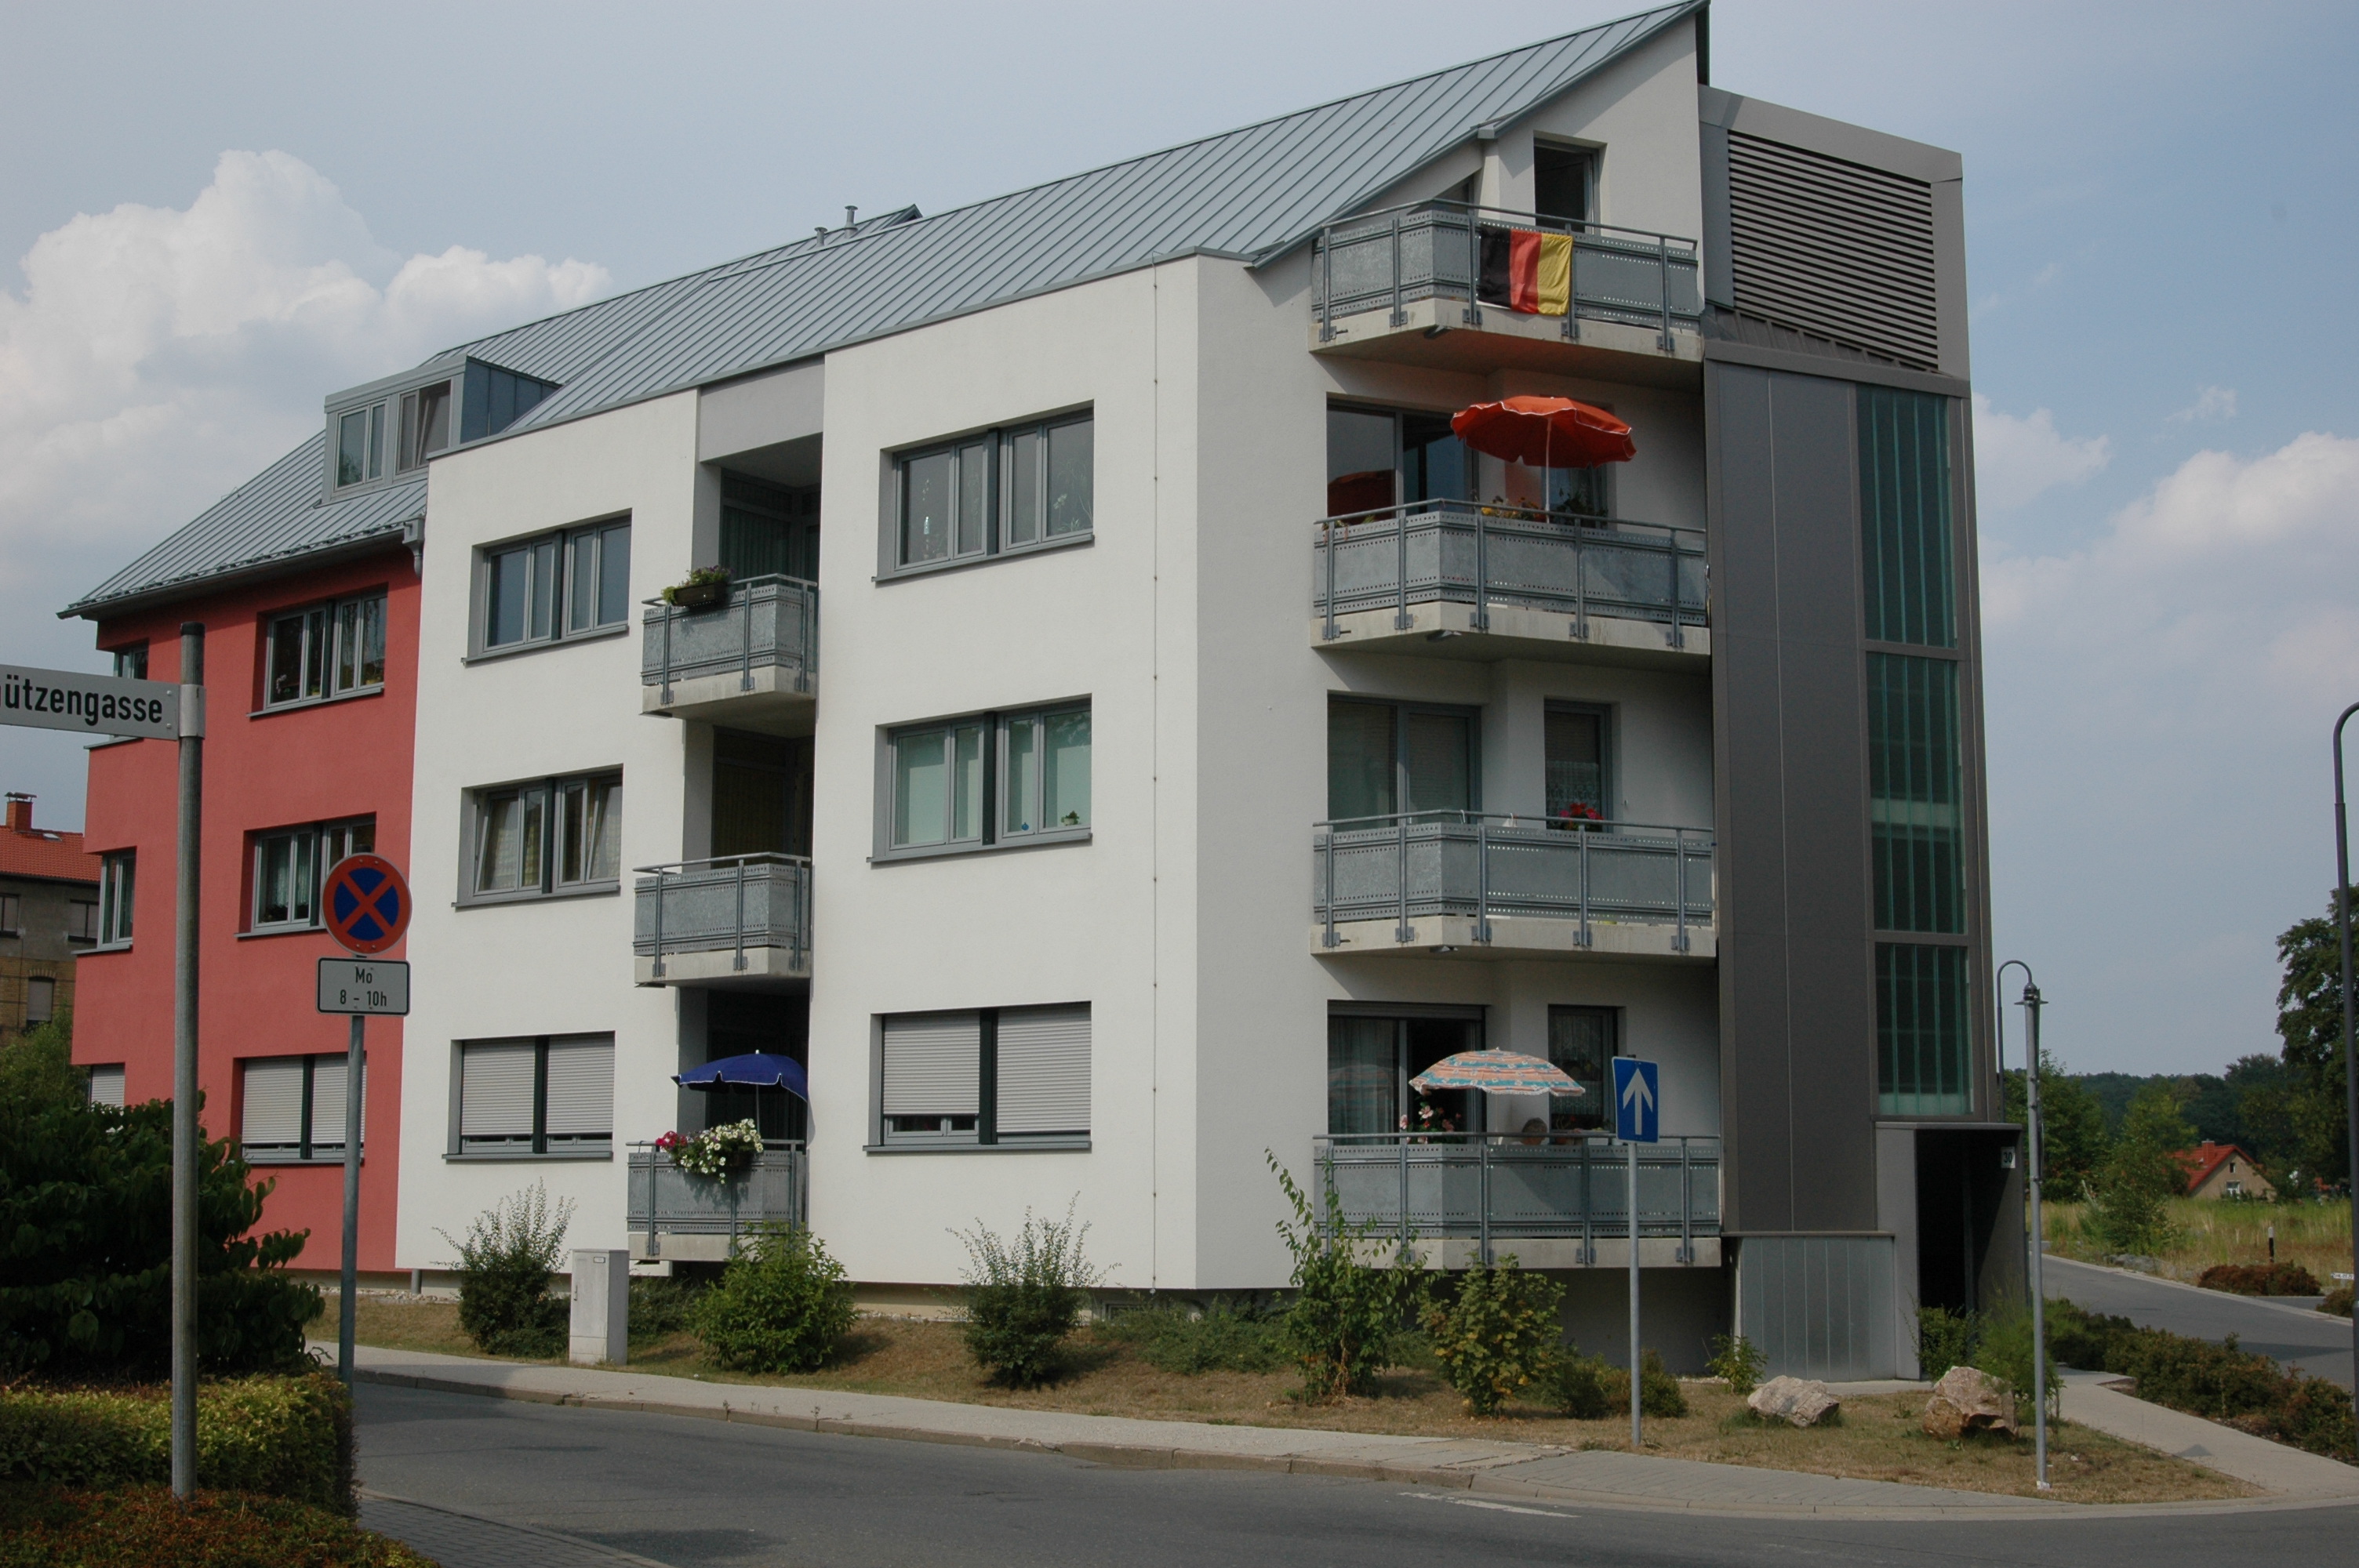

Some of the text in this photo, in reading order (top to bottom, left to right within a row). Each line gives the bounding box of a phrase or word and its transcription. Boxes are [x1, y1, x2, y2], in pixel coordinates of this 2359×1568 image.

[0, 673, 163, 726] ützengasse
[355, 967, 373, 984] Mo
[340, 989, 347, 1004] 8
[366, 990, 387, 1007] 10h
[2003, 1151, 2013, 1163] 30
